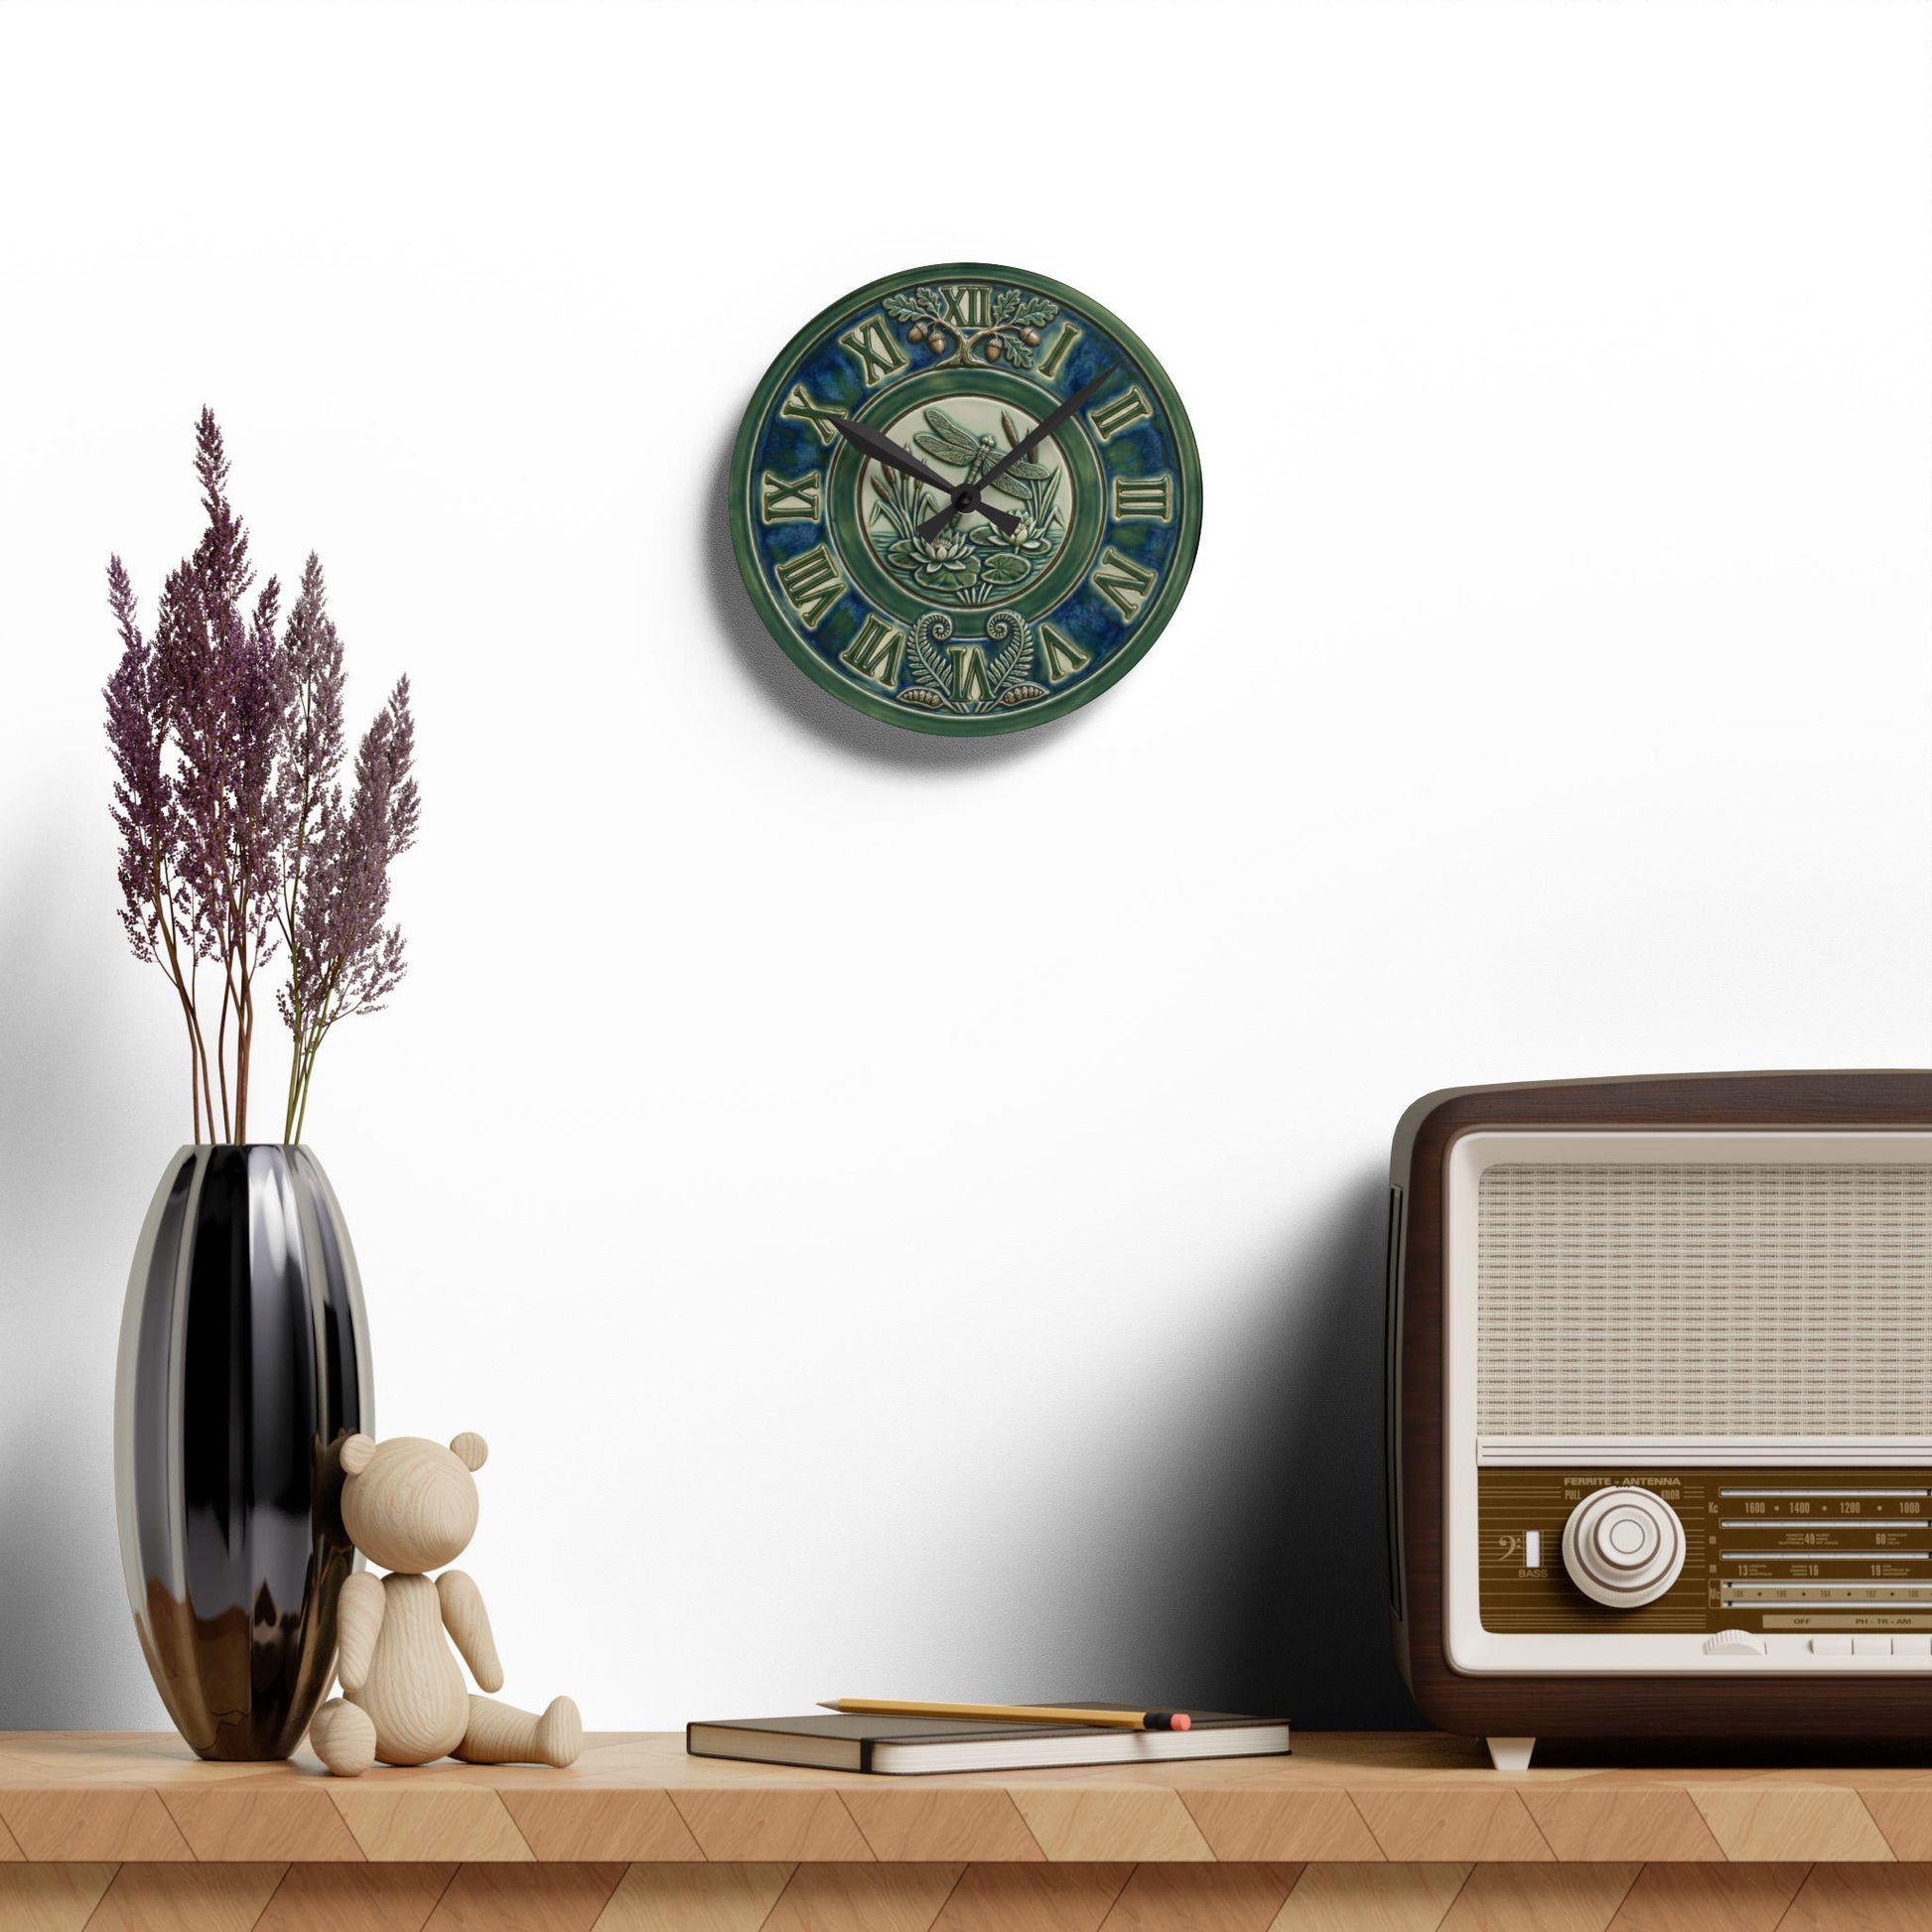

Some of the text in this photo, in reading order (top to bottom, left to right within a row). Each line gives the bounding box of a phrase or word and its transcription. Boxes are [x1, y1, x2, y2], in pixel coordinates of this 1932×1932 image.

[943, 285, 993, 328] XII
[839, 316, 907, 386] XI
[1038, 323, 1080, 377] I
[781, 383, 847, 444] X
[1089, 385, 1156, 442] II
[763, 471, 821, 523] IX
[1113, 476, 1173, 520] III
[775, 546, 846, 628] VIII
[1092, 548, 1157, 622] IV
[842, 615, 903, 687] VII
[947, 646, 996, 702] VI
[1039, 623, 1089, 682] V
[1565, 1489, 1581, 1500] PULL
[1745, 1502, 1765, 1514] 1600
[1789, 1502, 1810, 1514] 1400
[1840, 1502, 1861, 1514] 1200
[1899, 1502, 1920, 1514] 1000
[1805, 1533, 1815, 1545] 49
[1738, 1565, 1748, 1577] 13
